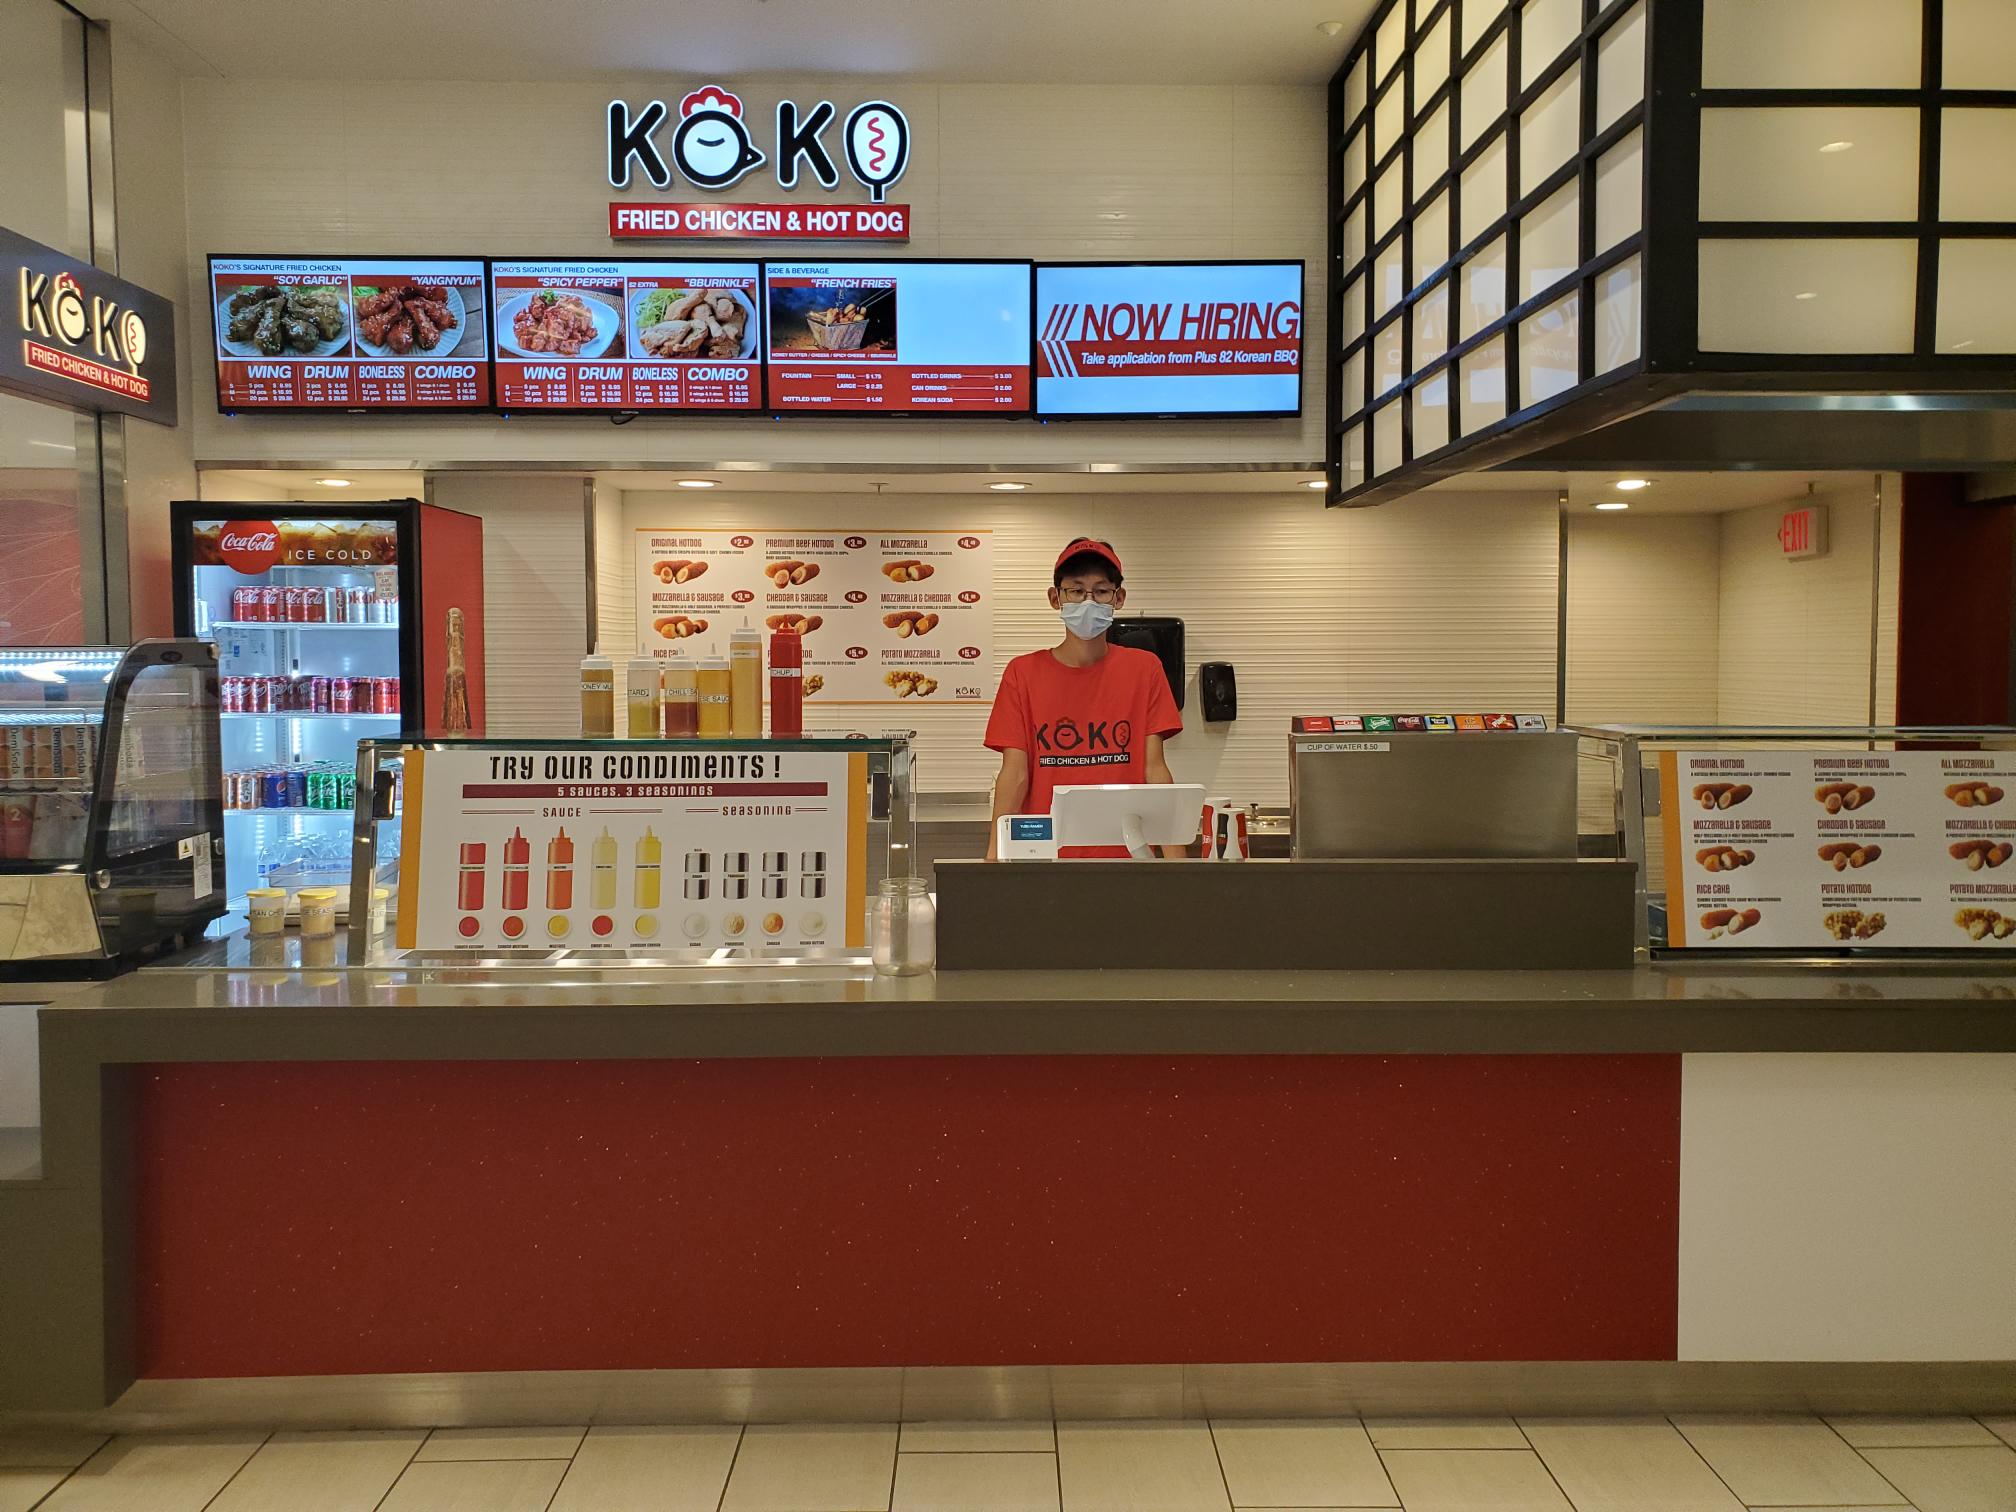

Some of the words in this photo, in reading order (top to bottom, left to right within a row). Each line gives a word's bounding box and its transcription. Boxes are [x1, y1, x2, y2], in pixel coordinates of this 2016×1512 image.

[608, 85, 910, 203] KOKO
[617, 210, 679, 230] FRIED
[685, 211, 780, 231] CHICKEN
[787, 212, 800, 231] &
[807, 212, 851, 231] HOT
[857, 212, 903, 232] DOG
[309, 264, 342, 272] CHICKEN
[22, 267, 147, 377] KOKO
[1080, 303, 1172, 341] NOW
[1178, 301, 1300, 340] HIRING
[1081, 352, 1105, 364] Take
[1108, 351, 1166, 367] application
[1168, 352, 1192, 364] from
[1194, 351, 1217, 363] Plus
[1219, 351, 1232, 363] 82
[1234, 350, 1272, 363] Korean
[1273, 349, 1299, 365] BBQ
[31, 346, 60, 368] FRIED
[61, 356, 102, 383] CHICKEN
[103, 371, 109, 384] &
[110, 372, 128, 390] HOT
[130, 378, 148, 397] DOG
[248, 365, 292, 379] WING
[304, 365, 349, 379] DRUM
[359, 365, 405, 379] BONELESS
[414, 365, 476, 379] COMBO
[523, 366, 567, 380] WING
[578, 366, 623, 380] DRUM
[632, 367, 678, 381] BONELESS
[687, 367, 749, 381] COMBO
[1784, 511, 1809, 553] EXIT
[221, 532, 278, 551] Coca-Cola
[880, 539, 890, 548] ALL
[288, 550, 316, 560] ICE
[326, 550, 372, 560] COLD
[1040, 757, 1056, 765] RIED
[1057, 757, 1089, 765] CHICKEN
[1098, 755, 1113, 763] HOT
[1113, 754, 1129, 762] DOG
[489, 756, 534, 780] TRY
[544, 755, 592, 780] OUR
[557, 786, 565, 797] 5
[626, 786, 632, 797] 3
[542, 807, 582, 817] SAUCE
